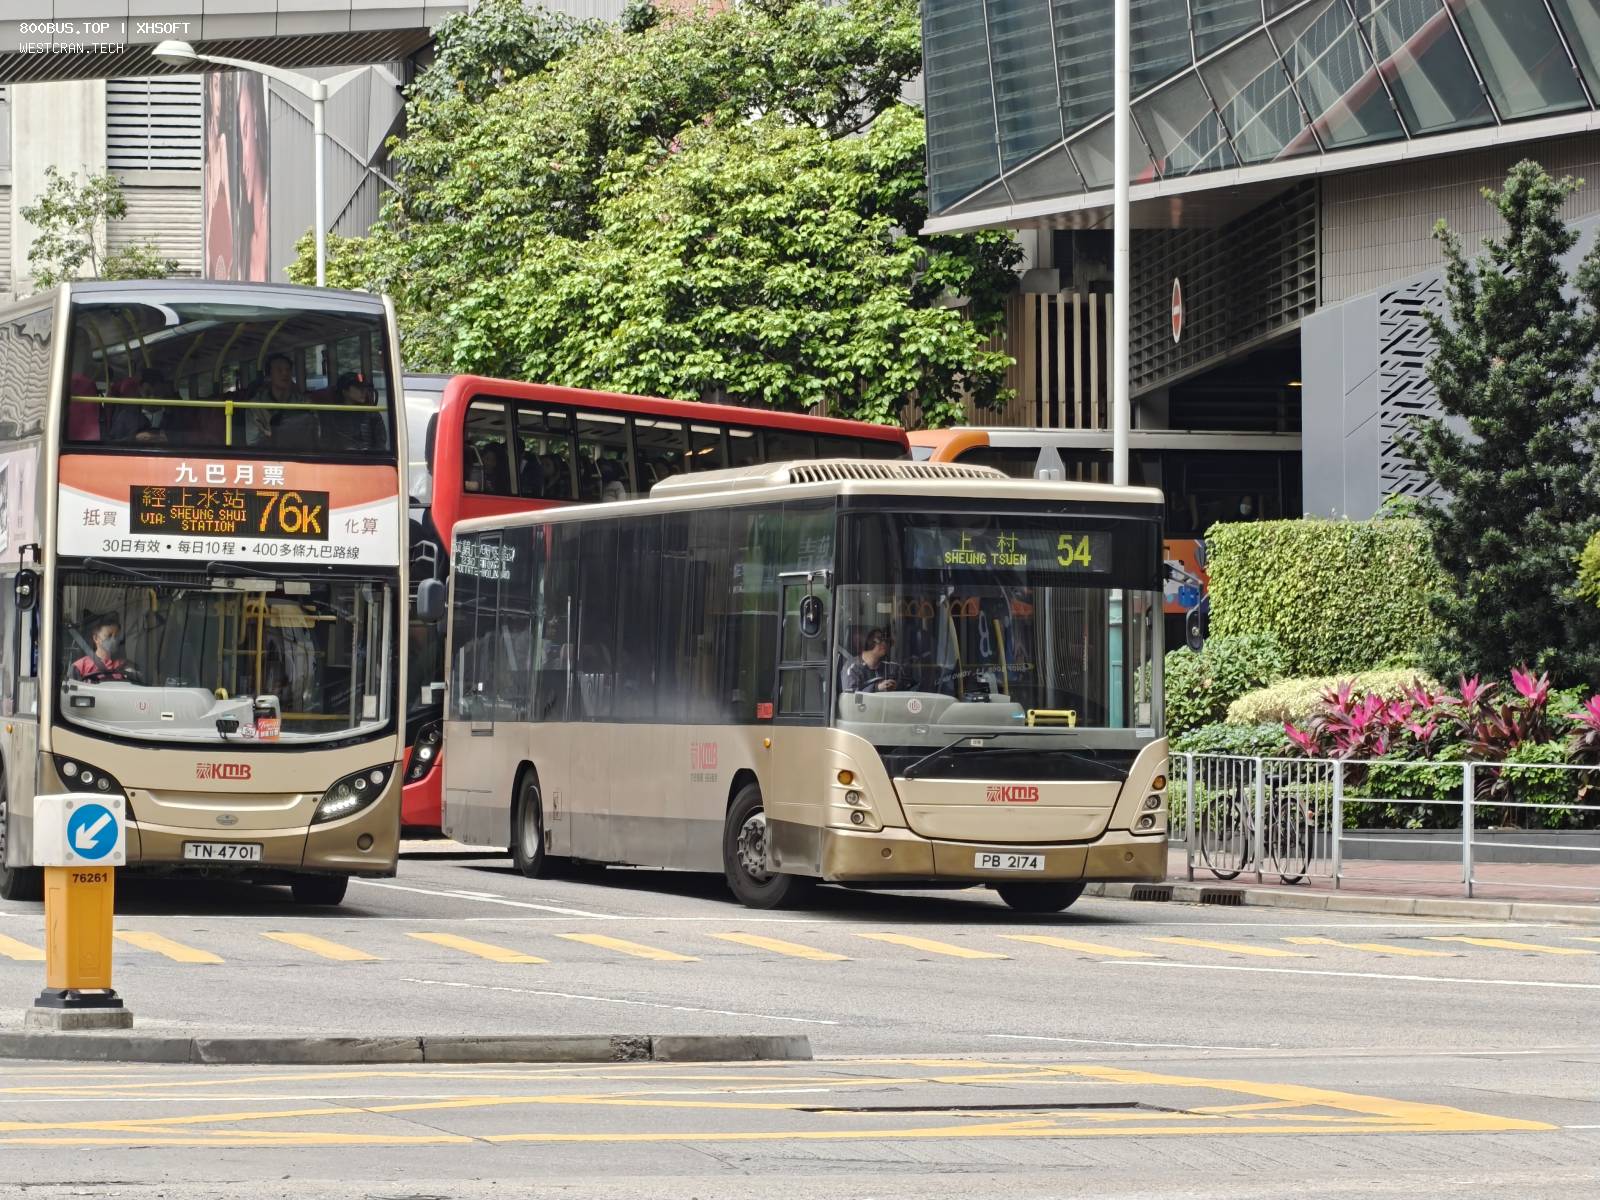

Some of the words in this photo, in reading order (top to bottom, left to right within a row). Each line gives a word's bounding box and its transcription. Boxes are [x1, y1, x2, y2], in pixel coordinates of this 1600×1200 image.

[175, 462, 285, 486] 九巴月票
[82, 507, 117, 527] 抵買
[140, 512, 166, 525] VIA:
[170, 508, 214, 520] SHEUNG
[219, 510, 247, 521] SHUI
[256, 490, 322, 534] 76K
[182, 519, 235, 532] STATION
[344, 517, 378, 535] 化算
[102, 538, 160, 553] 30日有效
[177, 540, 236, 555] 每日10程
[252, 543, 360, 560] 400多條九巴路線
[951, 530, 1019, 553] 上村
[944, 552, 986, 564] SHEUNG
[991, 553, 1027, 566] TSUEN
[1057, 534, 1092, 567] 54
[211, 763, 252, 780] KMB
[1001, 785, 1039, 802] KMB
[192, 844, 213, 858] TN
[218, 845, 254, 859] 4701
[982, 854, 1001, 867] PB
[1007, 856, 1037, 869] 2174
[72, 872, 108, 883] 76261
